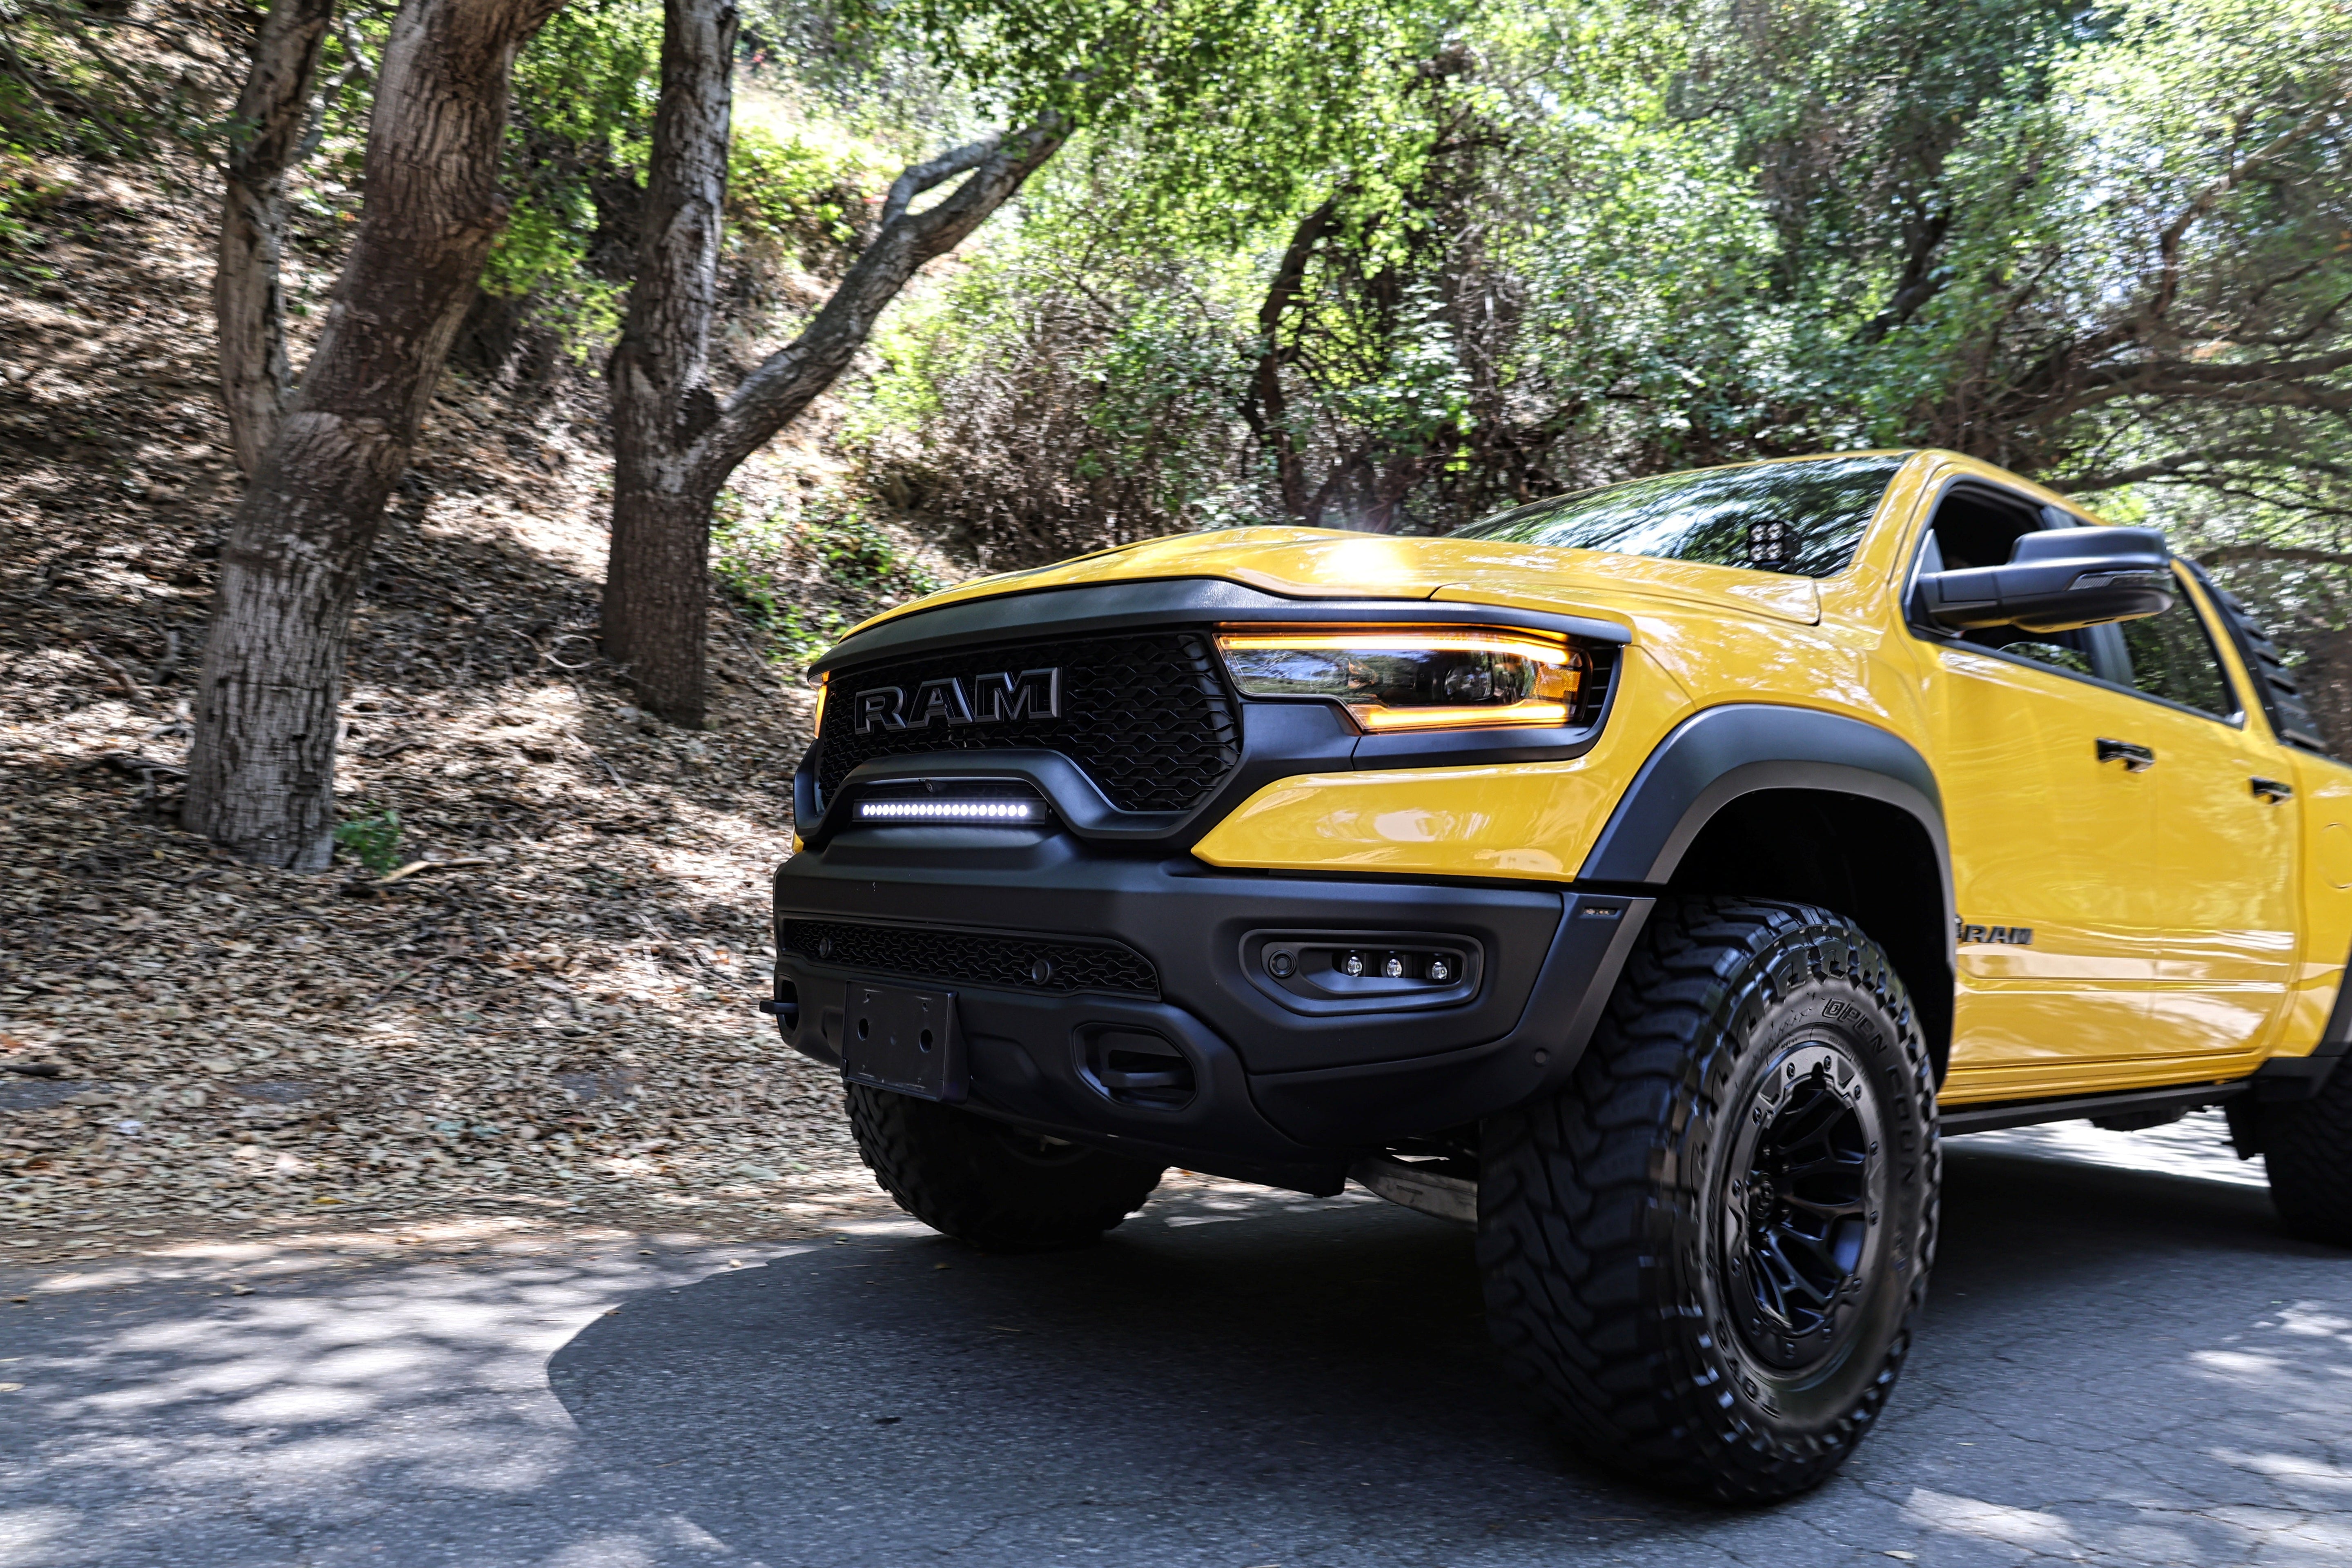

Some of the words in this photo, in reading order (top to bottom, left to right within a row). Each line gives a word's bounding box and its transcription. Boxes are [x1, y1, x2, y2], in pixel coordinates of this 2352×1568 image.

[855, 667, 1062, 735] RAM
[1963, 924, 2034, 945] RAM
[1822, 998, 1888, 1058] OPEN
